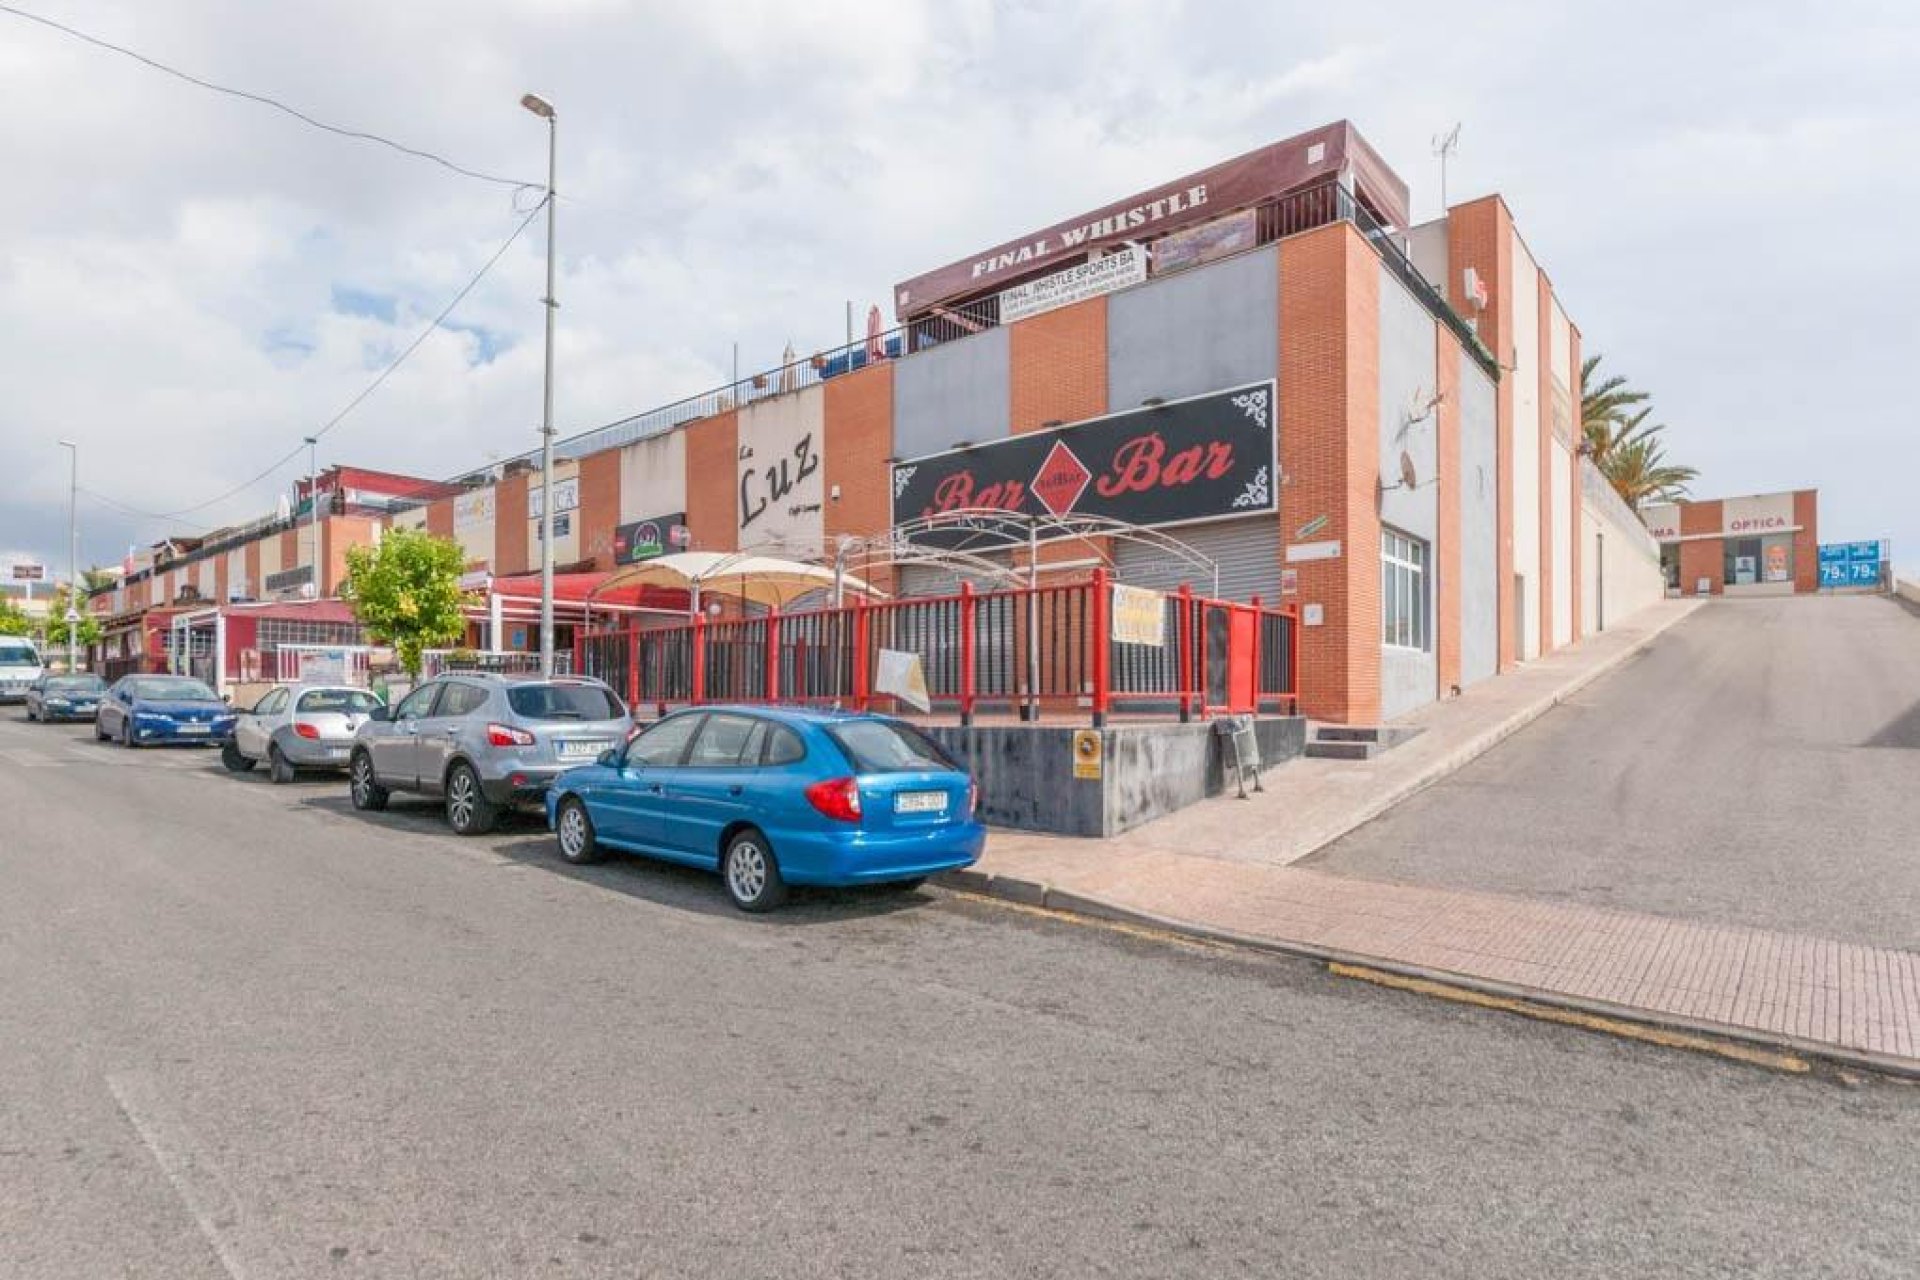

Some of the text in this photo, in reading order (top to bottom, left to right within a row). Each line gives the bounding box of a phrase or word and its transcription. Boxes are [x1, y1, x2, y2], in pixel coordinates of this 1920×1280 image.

[972, 241, 1048, 278] FINAL
[1061, 184, 1208, 246] WHISTLE
[1033, 270, 1074, 291] WHISTLE
[1076, 256, 1117, 281] SPORTS
[740, 432, 818, 529] Luz
[1097, 432, 1235, 497] Bar
[922, 470, 1025, 518] Bar
[1731, 517, 1785, 530] OPTICA
